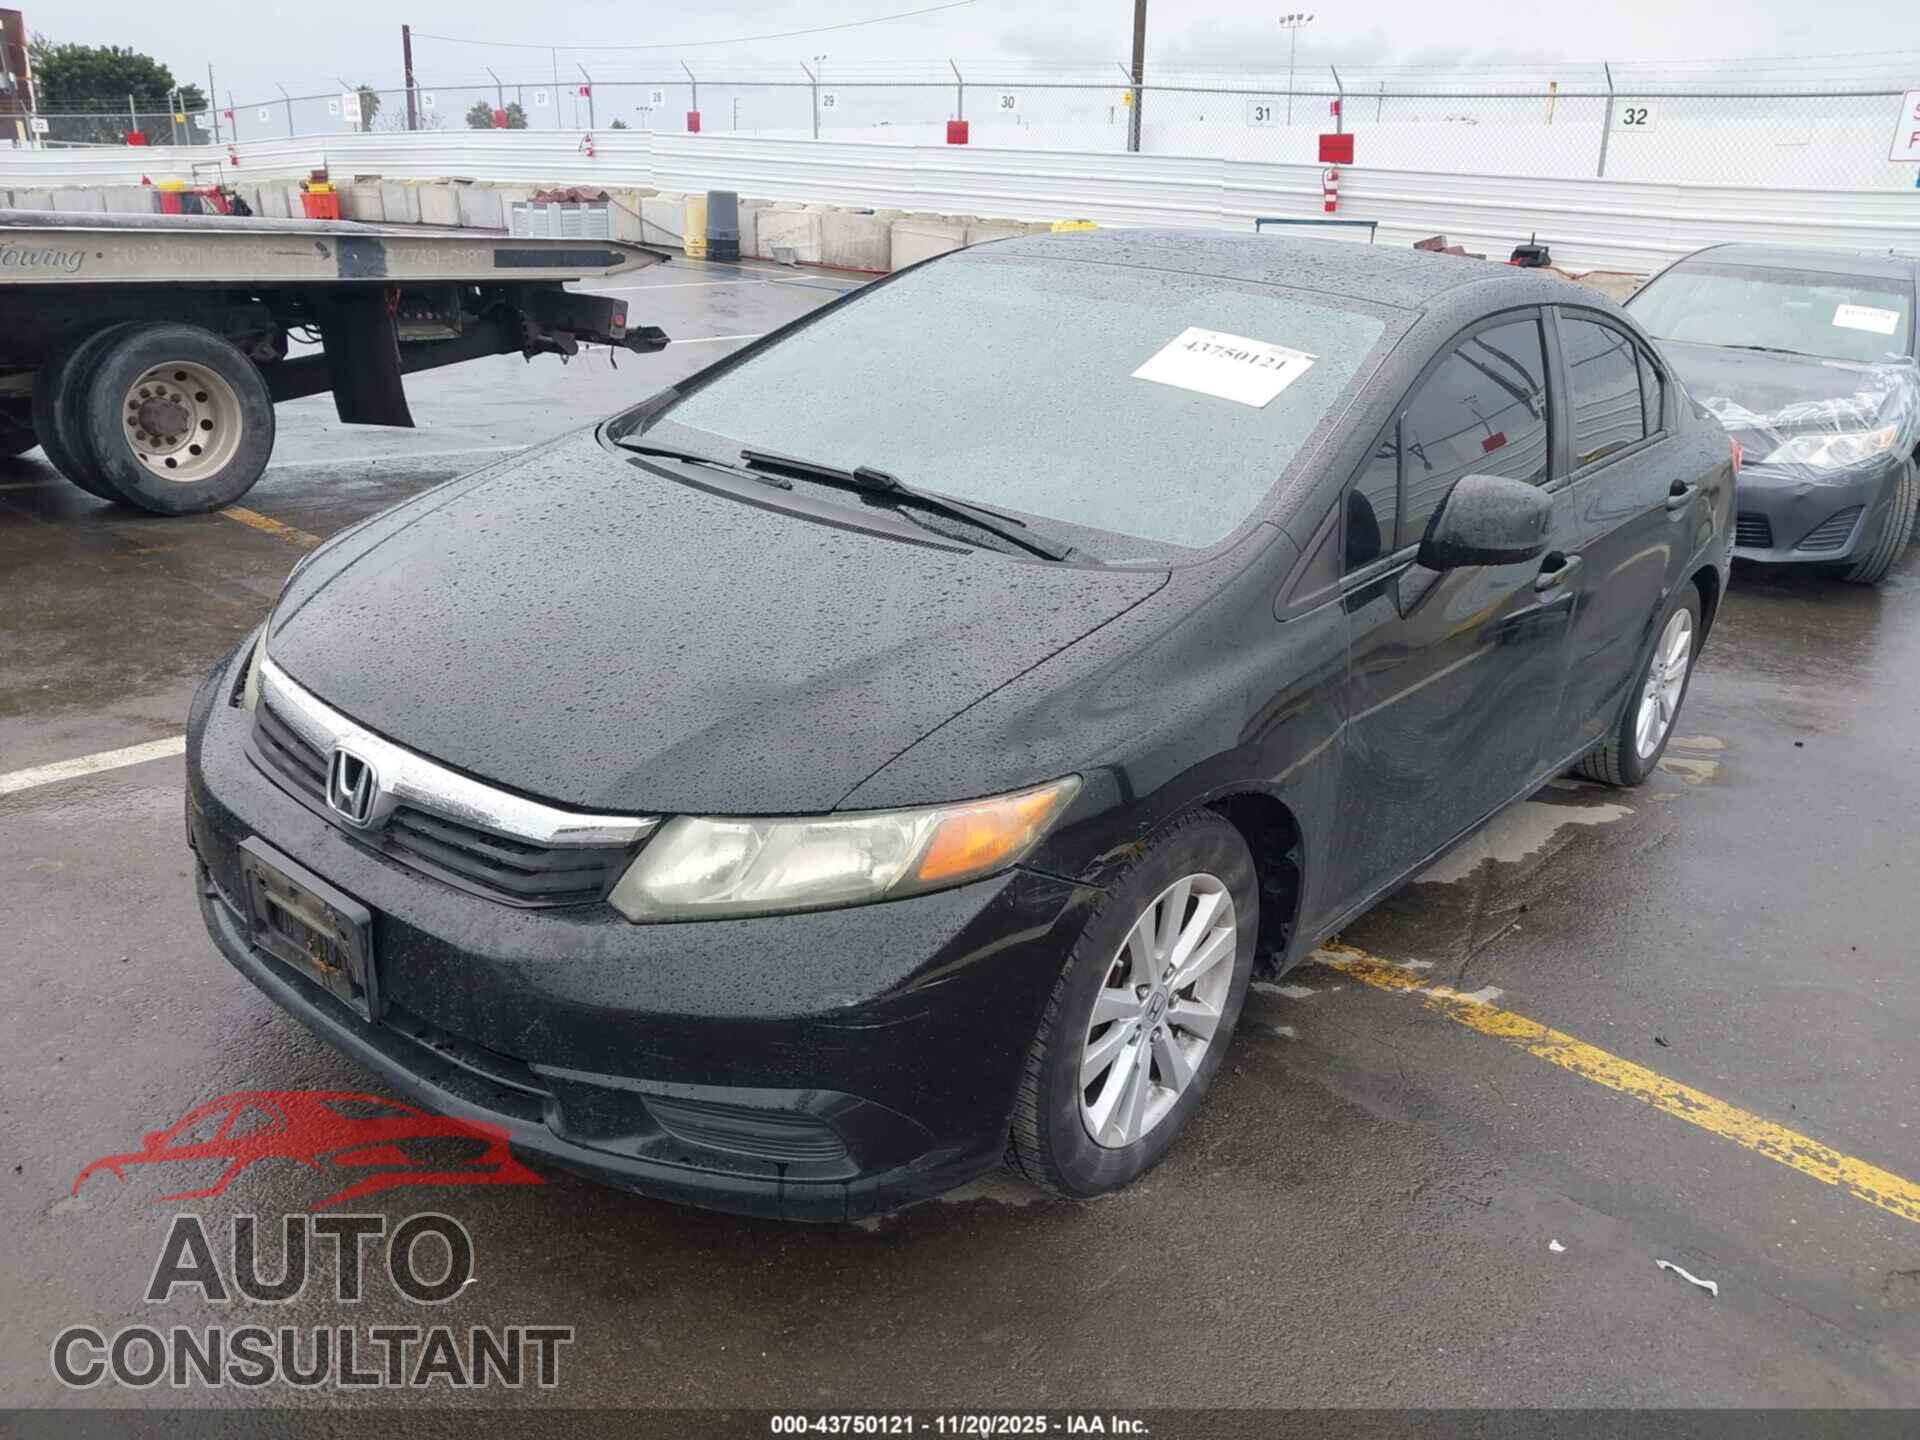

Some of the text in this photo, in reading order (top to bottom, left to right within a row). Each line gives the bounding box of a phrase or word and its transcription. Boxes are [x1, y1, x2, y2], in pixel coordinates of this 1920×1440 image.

[1000, 95, 1015, 109] 30
[1255, 106, 1271, 121] 31
[1623, 108, 1649, 125] 32
[0, 246, 87, 274] owing
[1185, 340, 1287, 371] 43750121
